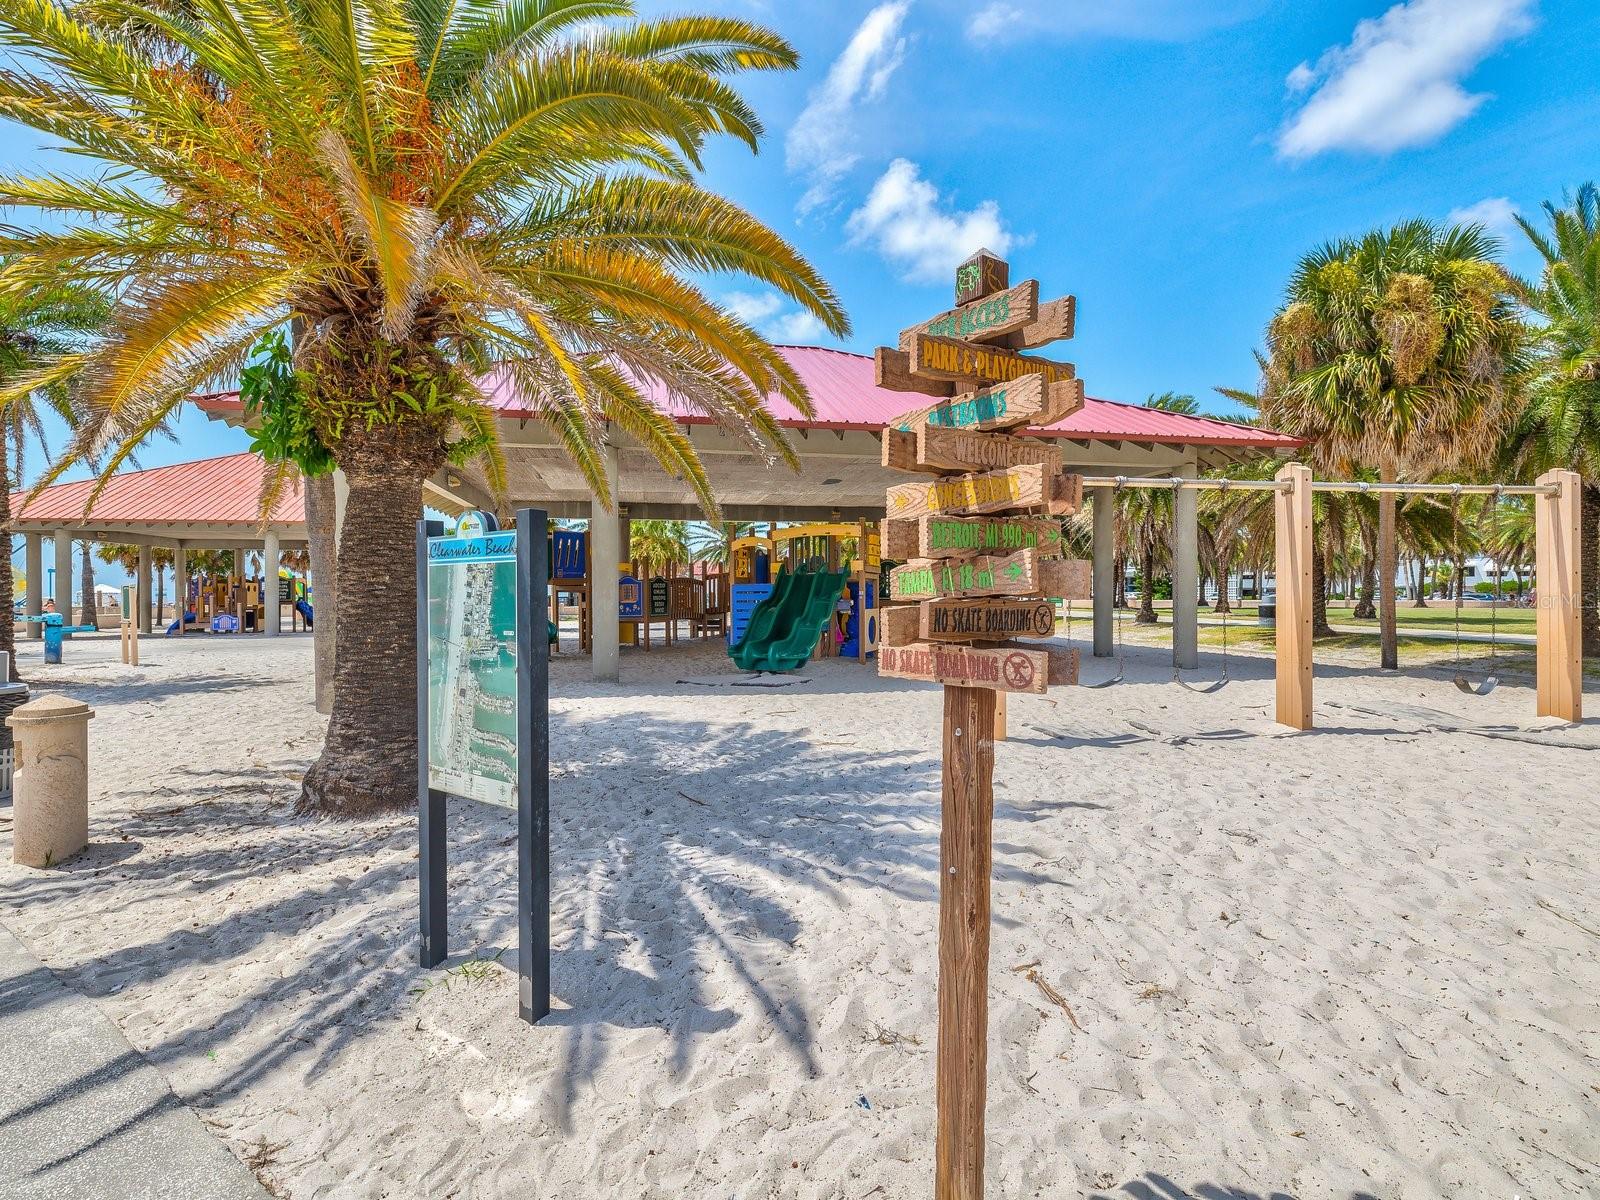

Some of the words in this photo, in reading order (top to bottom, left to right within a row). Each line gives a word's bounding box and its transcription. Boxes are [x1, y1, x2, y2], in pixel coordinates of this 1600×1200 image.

[960, 294, 1010, 337] ACCESS
[923, 339, 959, 373] PARK
[963, 350, 972, 374] &
[955, 436, 1013, 467] WELCOME
[429, 542, 481, 559] Clearwater
[484, 536, 516, 556] Beach
[931, 521, 981, 550] DETROIT,
[985, 522, 998, 548] MI
[1003, 523, 1023, 548] 990
[1025, 529, 1038, 549] mi
[959, 562, 974, 591] 18
[934, 607, 948, 633] NO
[952, 607, 982, 633] SKATE
[985, 607, 1031, 633] BOARDING
[881, 649, 897, 672] NO
[900, 649, 933, 676] SKATE
[935, 652, 999, 682] BOARDING
